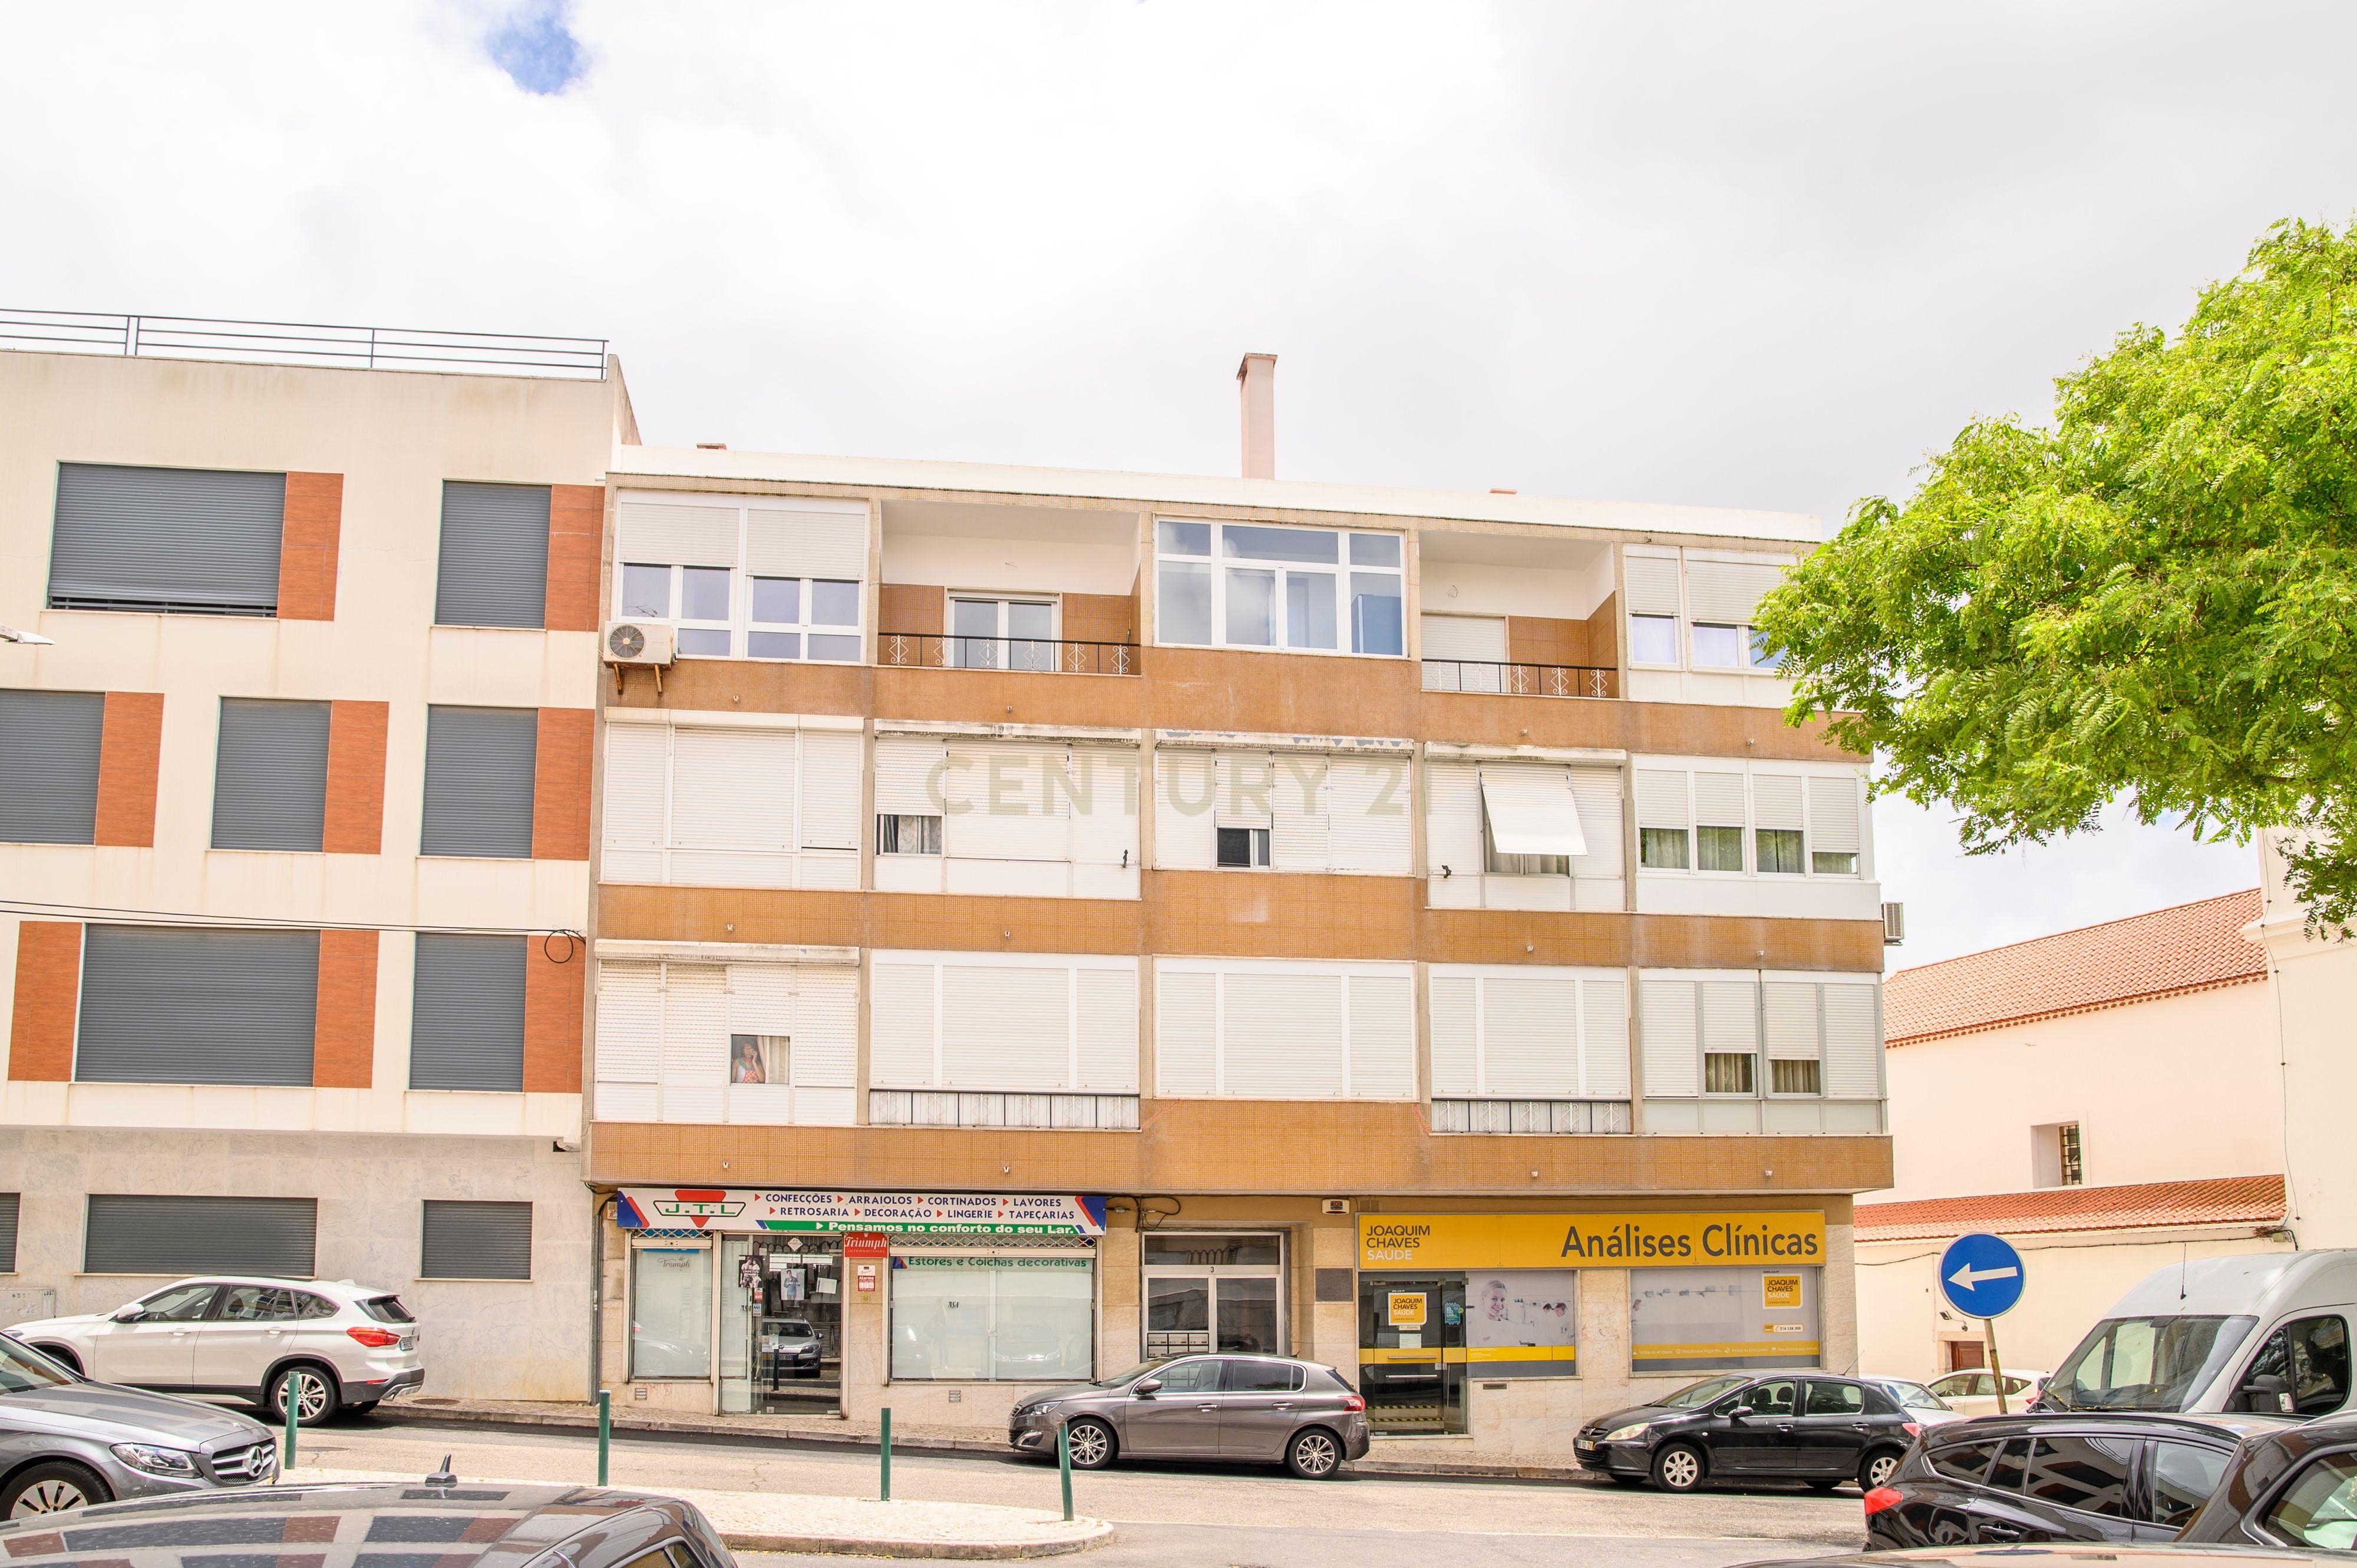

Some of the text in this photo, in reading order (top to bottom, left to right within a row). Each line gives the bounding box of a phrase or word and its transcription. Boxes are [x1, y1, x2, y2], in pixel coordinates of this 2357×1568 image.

[765, 1192, 1061, 1207] CONFECÇÕES ARRAIOLOS CORTINADOS LAVORES
[780, 1207, 1074, 1220] RETROSARIA DECORAÇÃO LINGERIE TAPEÇARIAS
[828, 1222, 902, 1233] Pensamos
[929, 1224, 990, 1233] conforto
[995, 1224, 1012, 1234] do
[1048, 1226, 1074, 1234] Lar.
[1366, 1225, 1430, 1236] JOAQUIM
[844, 1236, 887, 1250] Triumph
[1366, 1237, 1420, 1248] CHAVES
[1560, 1223, 1818, 1257] Análises Clínicas
[1367, 1248, 1412, 1260] SAÚDE
[656, 1257, 691, 1270] Triumph
[908, 1256, 952, 1266] Estores
[968, 1257, 1014, 1267] Colchas
[1018, 1258, 1087, 1267] decorativas
